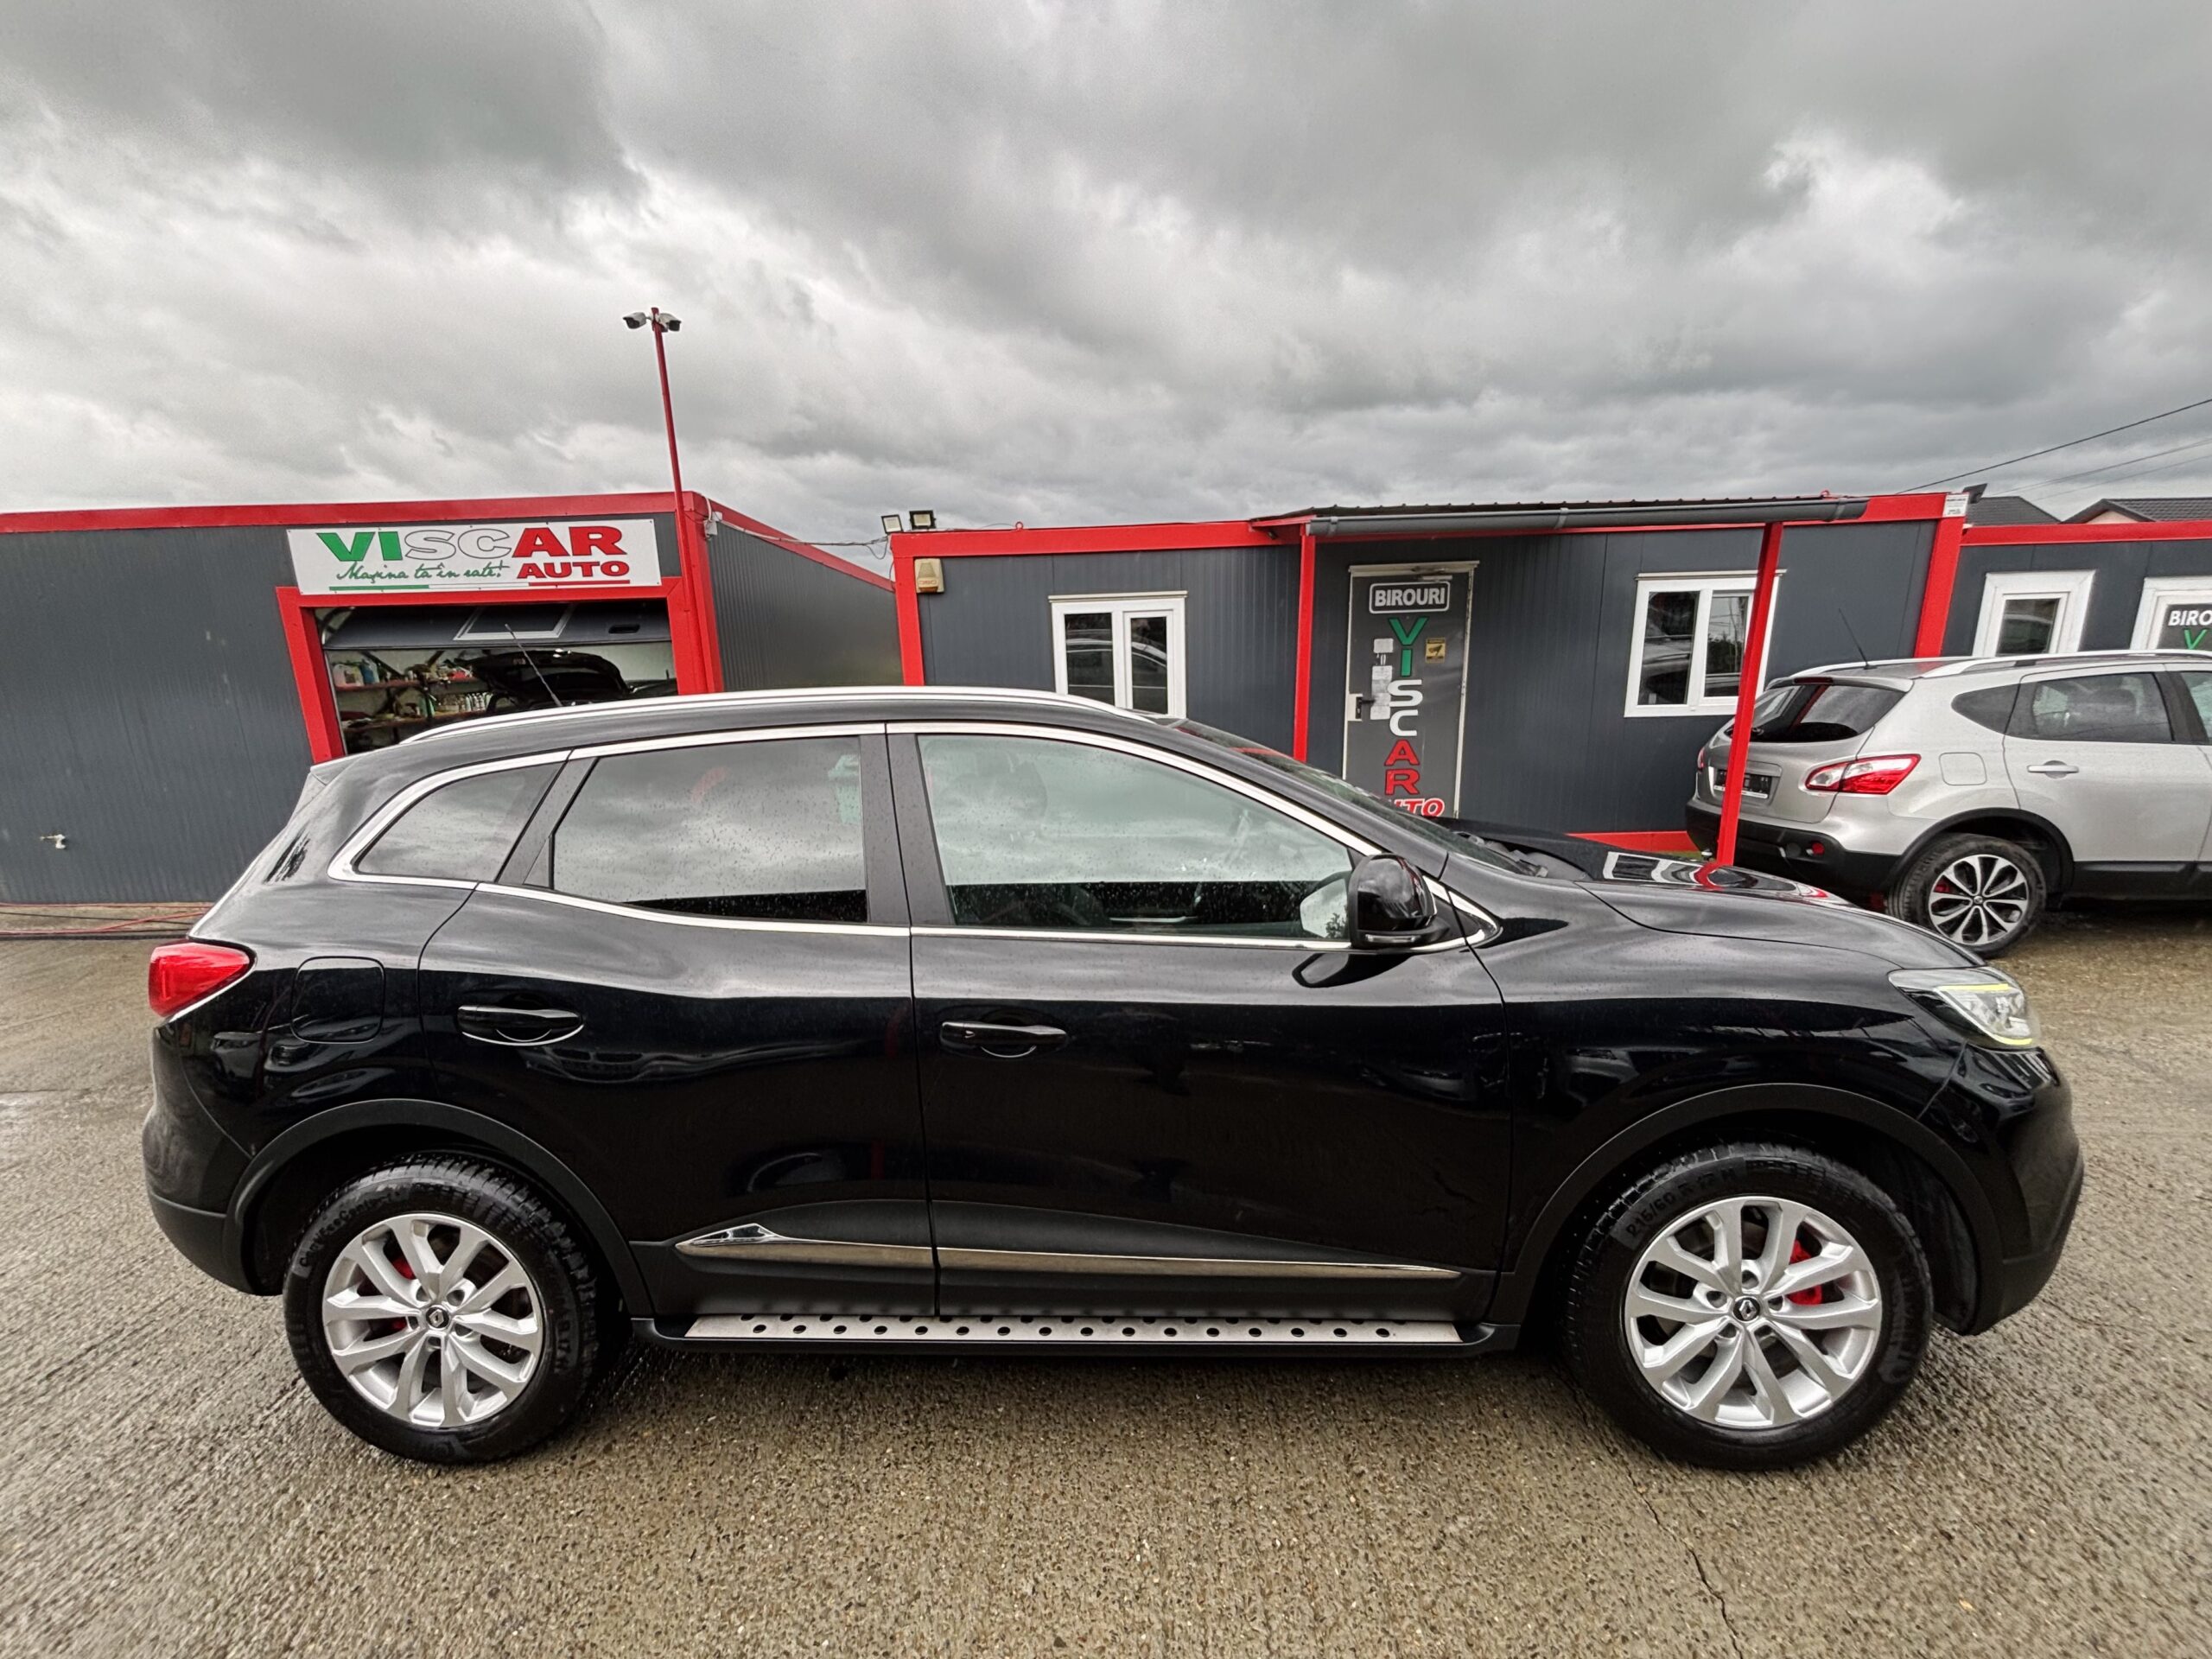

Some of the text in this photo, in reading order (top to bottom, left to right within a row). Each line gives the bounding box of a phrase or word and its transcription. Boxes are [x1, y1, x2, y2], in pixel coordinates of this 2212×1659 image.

[316, 526, 627, 562] VISCAR
[517, 560, 630, 580] AUTO
[1374, 588, 1446, 607] BIROURI
[1384, 616, 1429, 796] VISCAR
[1393, 798, 1446, 818] TO
